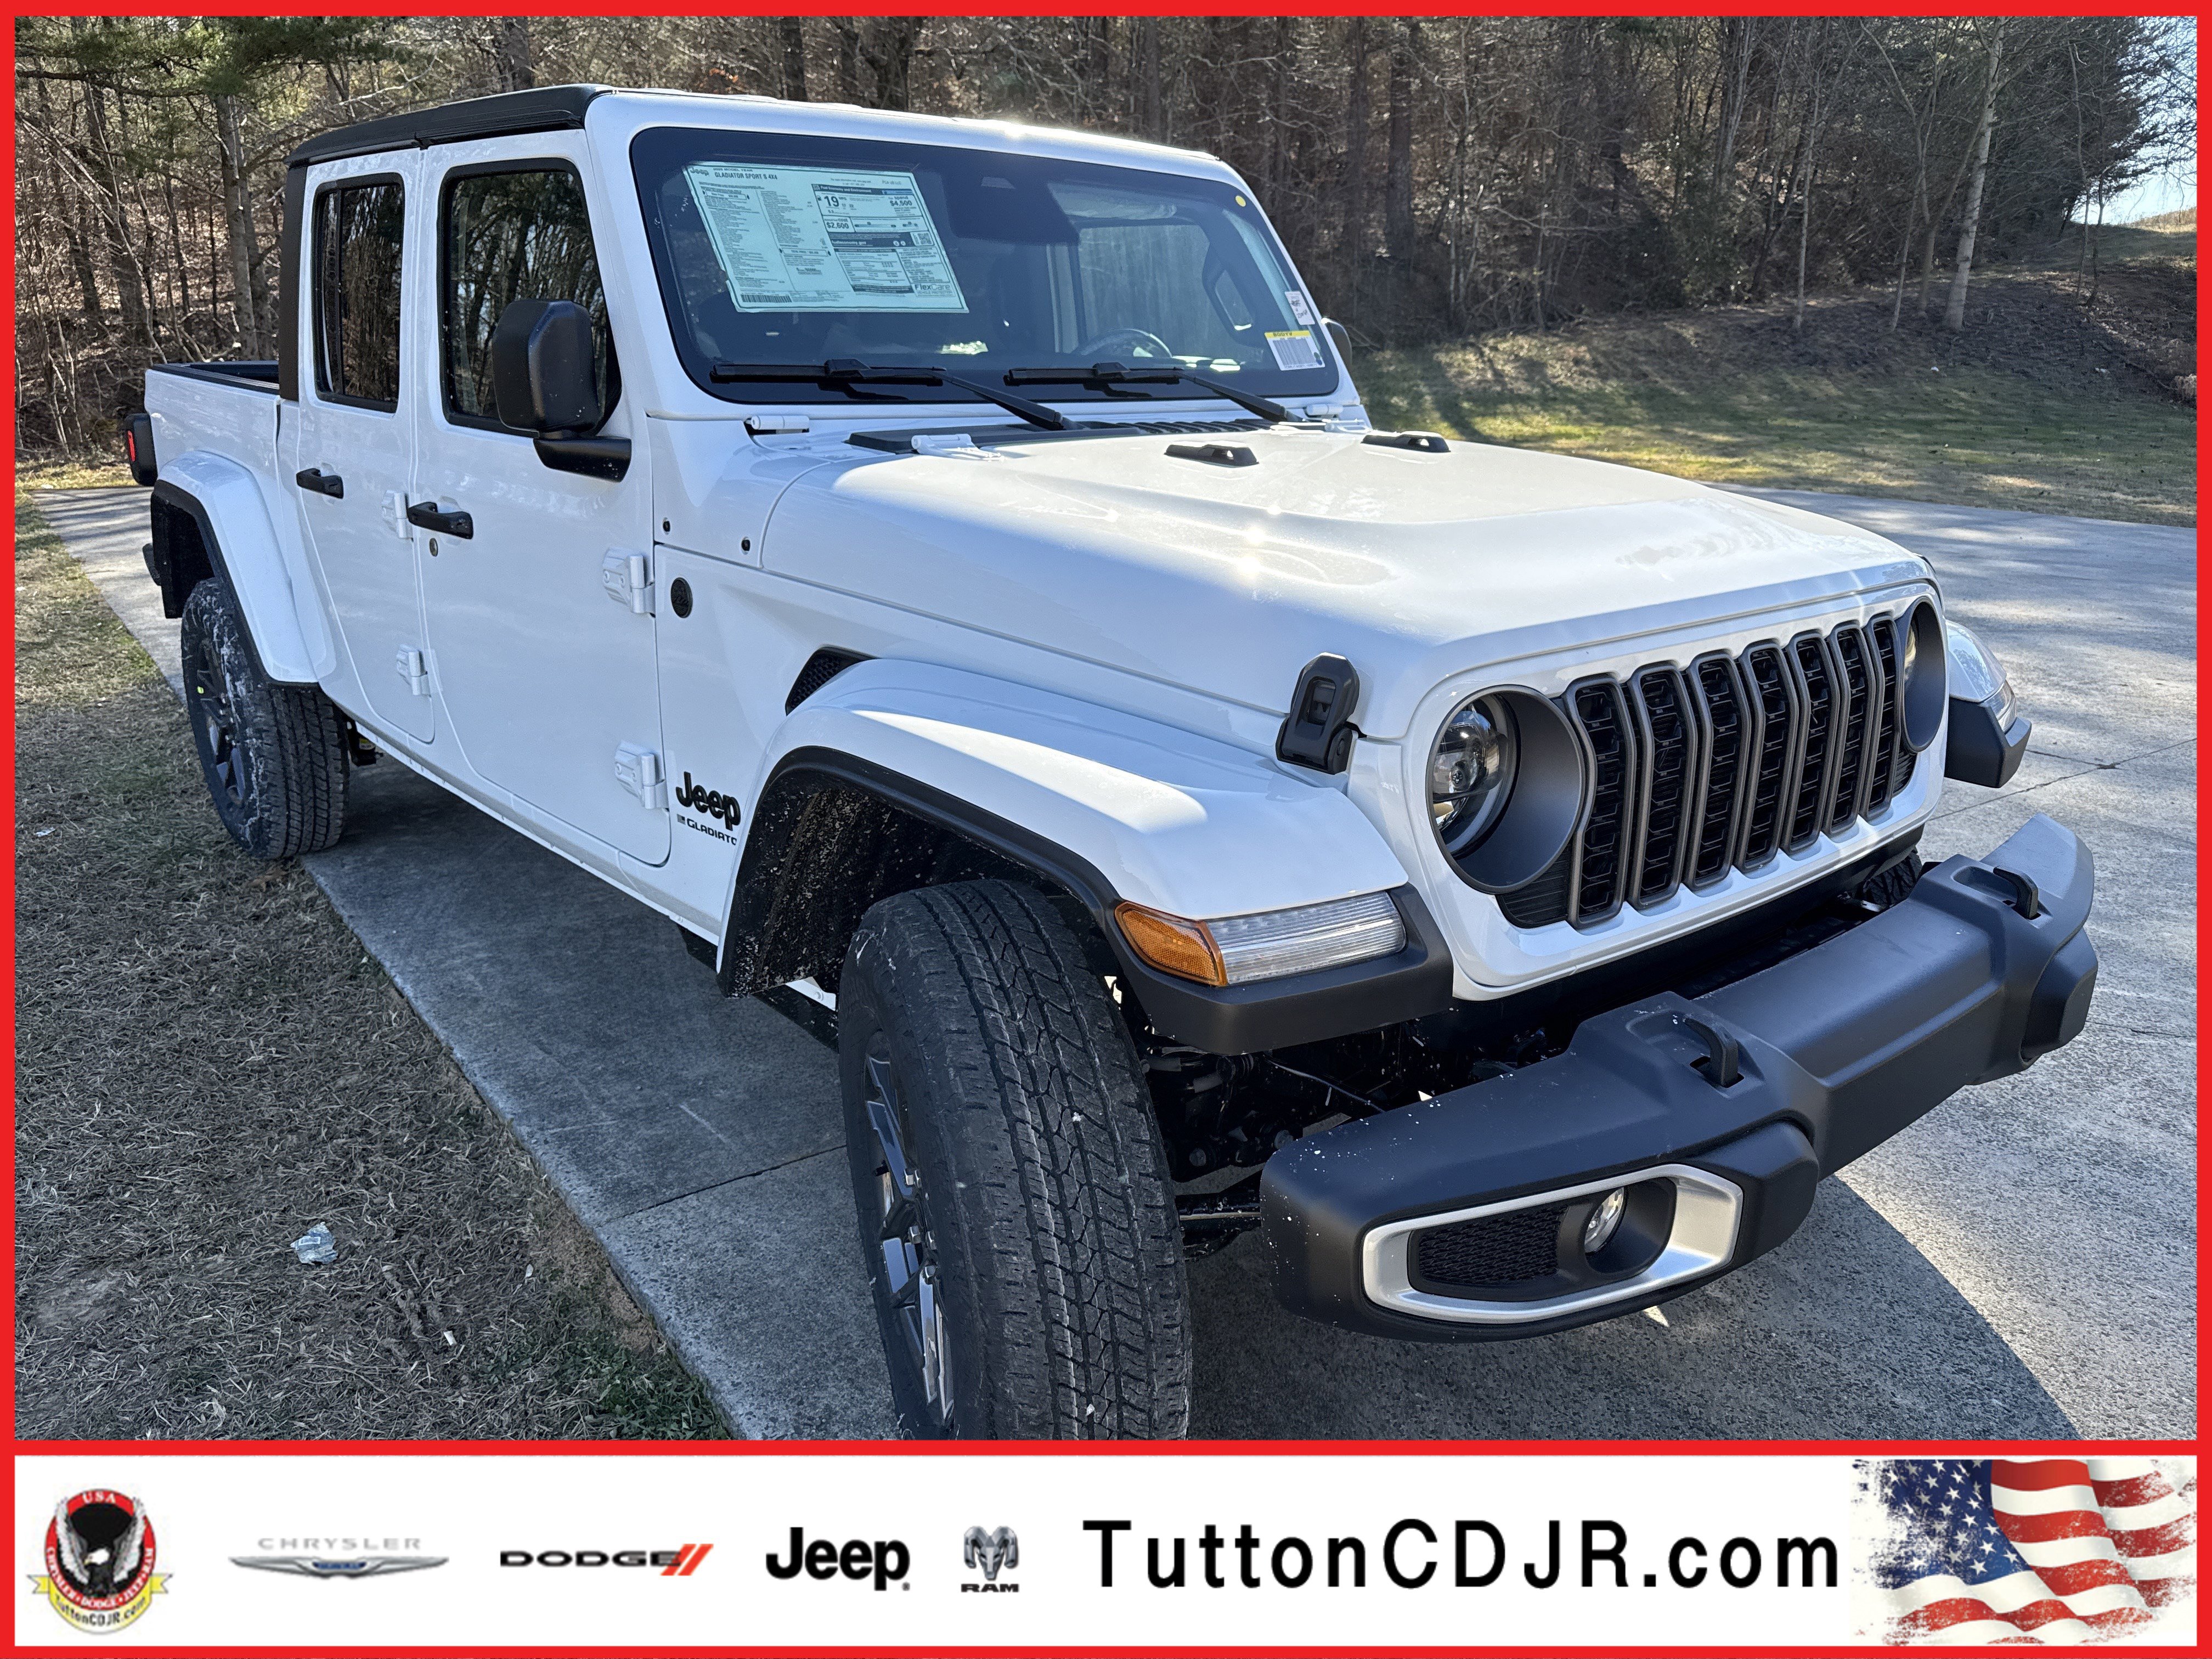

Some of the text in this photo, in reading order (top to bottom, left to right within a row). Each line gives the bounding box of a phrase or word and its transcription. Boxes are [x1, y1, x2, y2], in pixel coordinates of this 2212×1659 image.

[690, 167, 709, 176] Jeep
[824, 196, 839, 207] 19
[675, 771, 741, 831] Jeep
